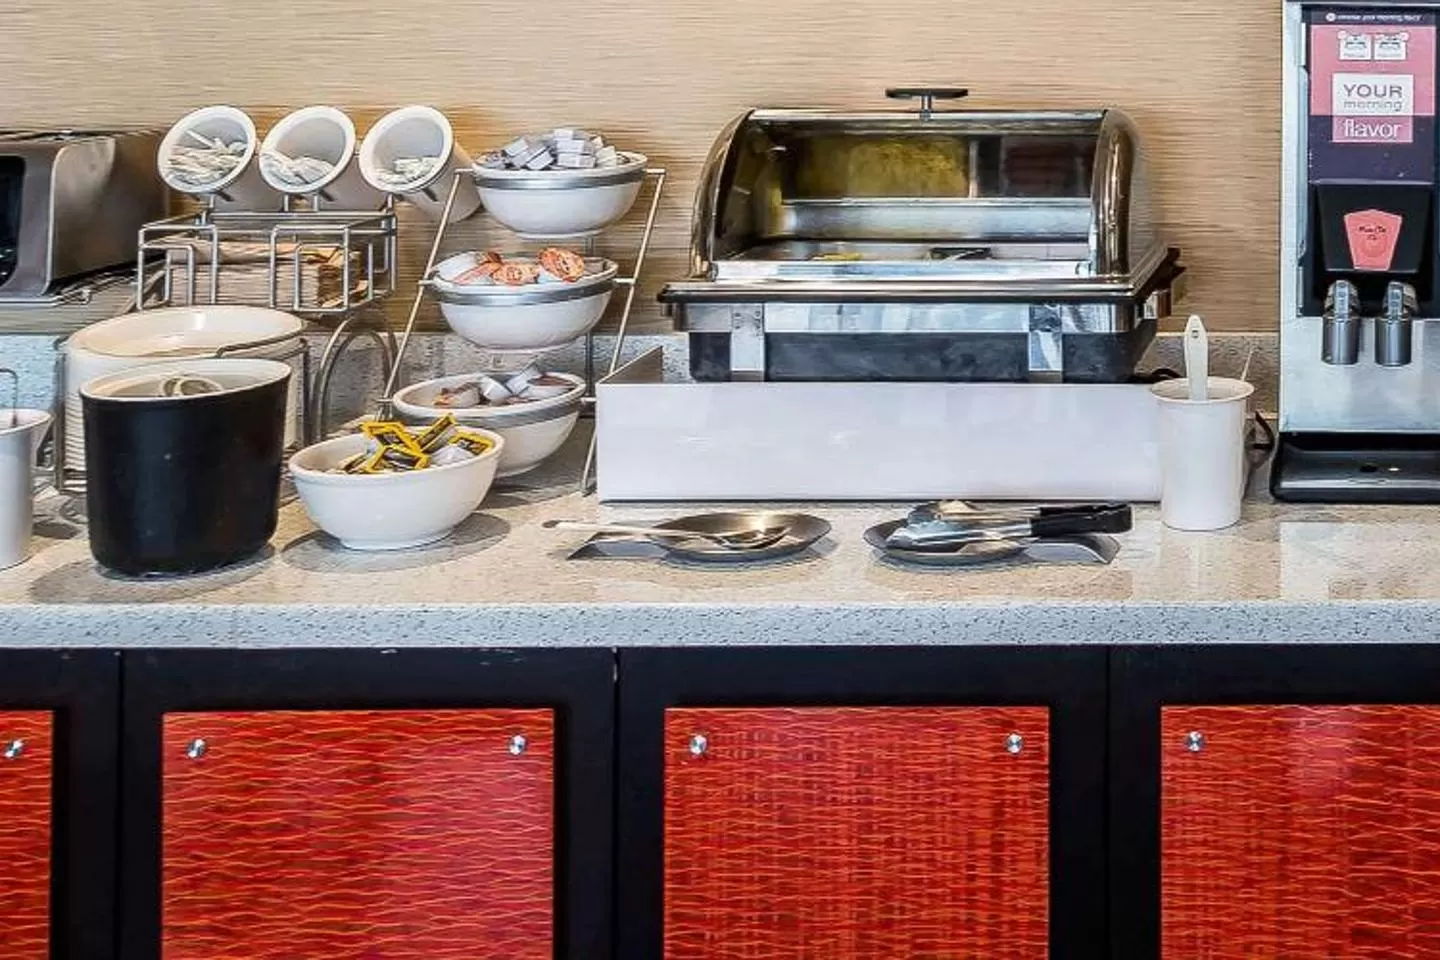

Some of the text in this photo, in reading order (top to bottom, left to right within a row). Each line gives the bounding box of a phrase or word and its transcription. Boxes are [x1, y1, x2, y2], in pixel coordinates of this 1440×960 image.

[1343, 84, 1403, 98] YOUR
[1343, 100, 1403, 112] morning
[1342, 119, 1402, 138] flavor
